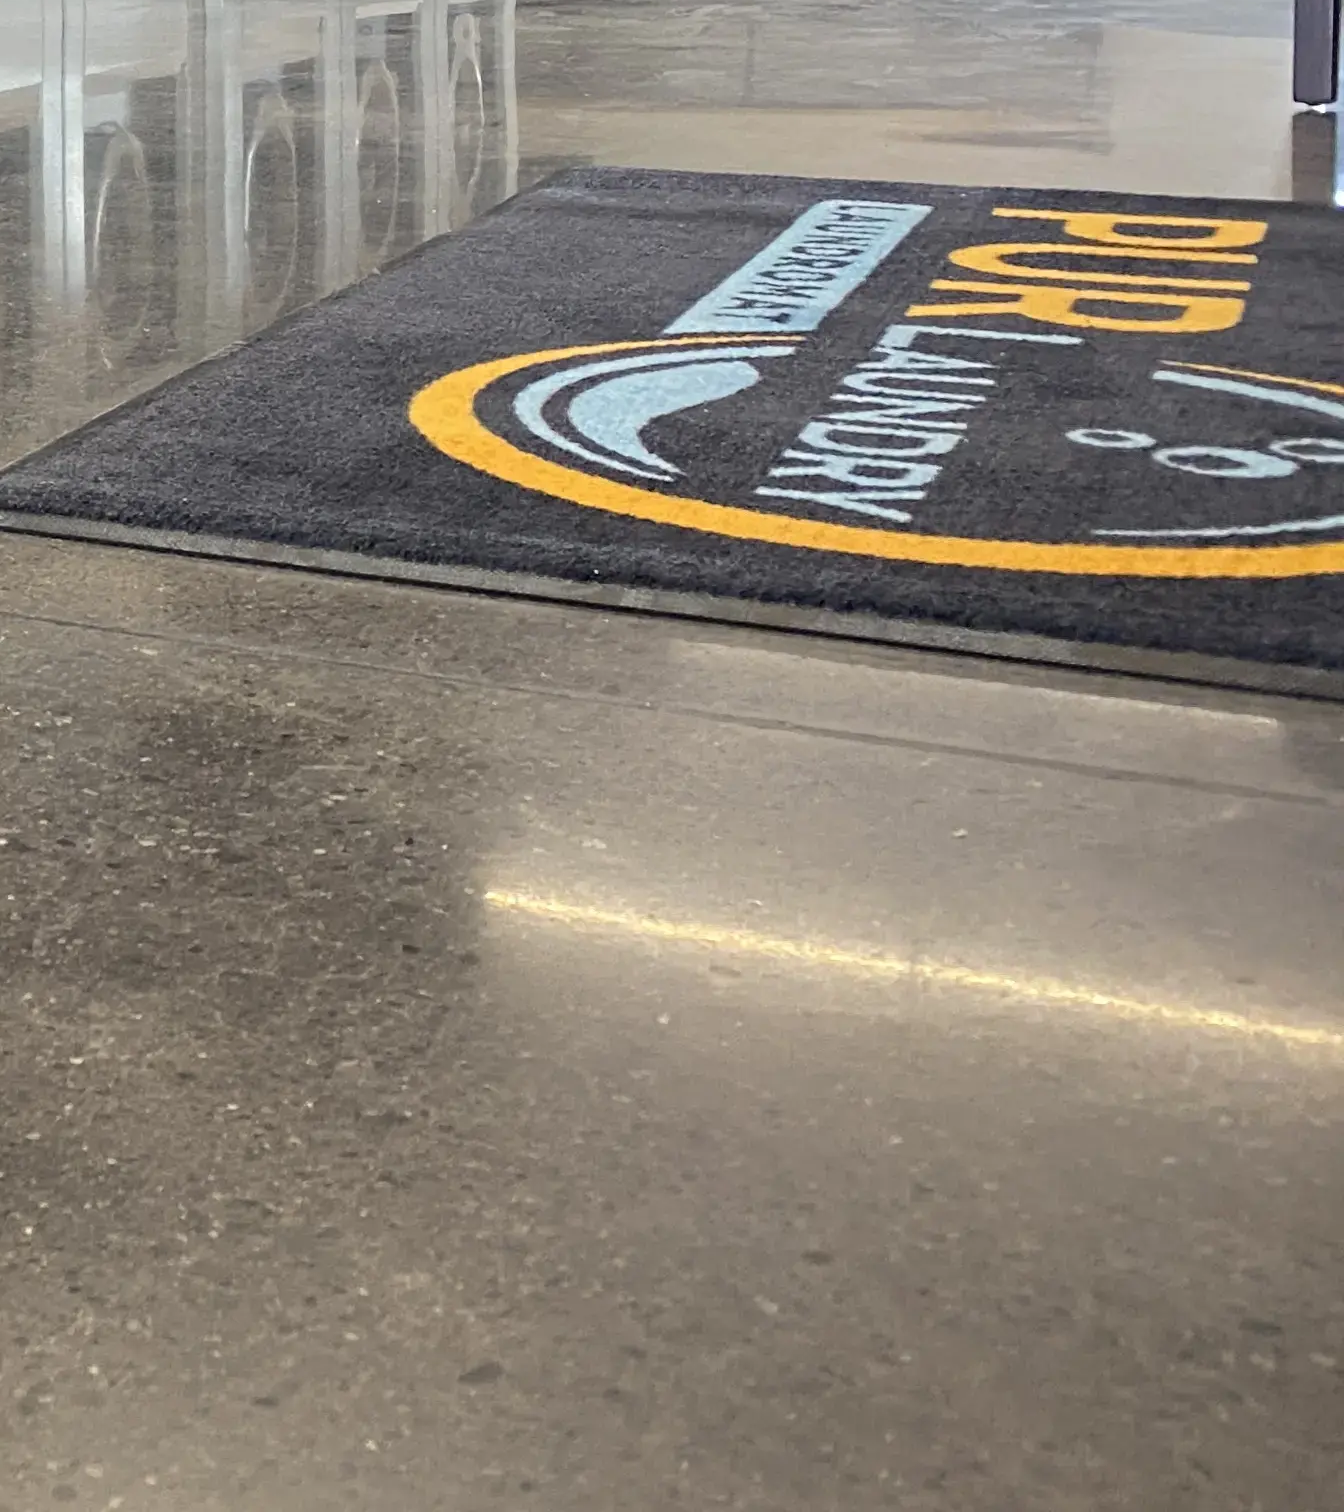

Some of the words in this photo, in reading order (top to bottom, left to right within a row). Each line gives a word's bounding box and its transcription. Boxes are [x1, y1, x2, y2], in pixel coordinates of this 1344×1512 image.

[711, 204, 909, 324] LAUNDROMAT
[906, 206, 1268, 334] PUR
[755, 324, 1085, 523] LAUNDRY
